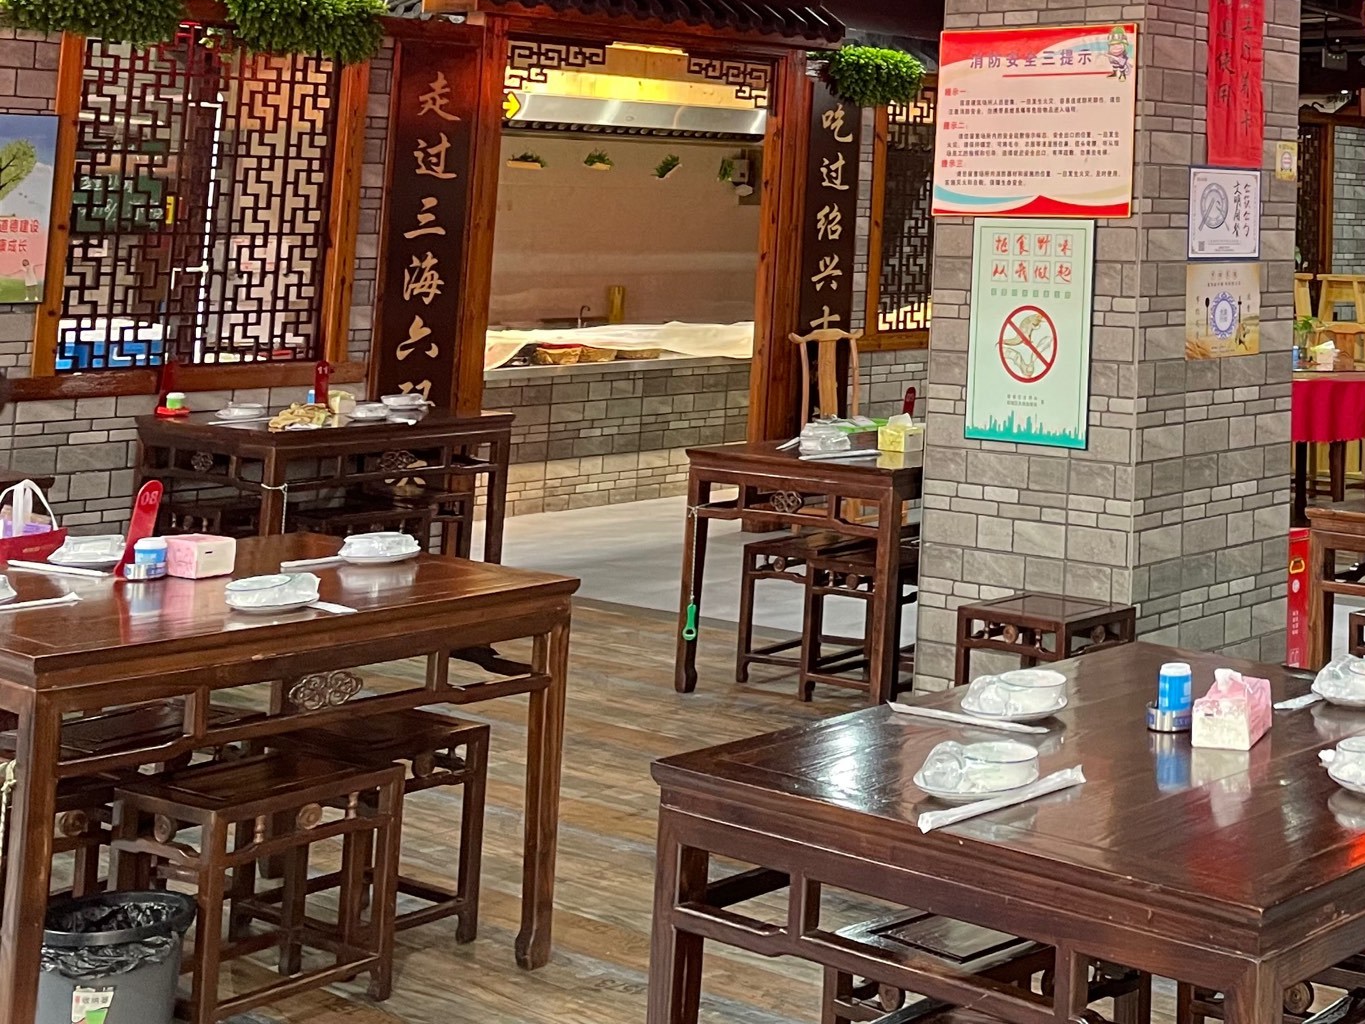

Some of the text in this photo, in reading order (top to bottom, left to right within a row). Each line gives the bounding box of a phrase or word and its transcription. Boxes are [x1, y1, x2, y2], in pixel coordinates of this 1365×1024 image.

[970, 48, 1092, 70] 消防安全三提示
[1232, 180, 1242, 238] 文明用餐
[992, 262, 1072, 283] 从我做起
[317, 366, 328, 375] 11
[140, 490, 159, 506] 08
